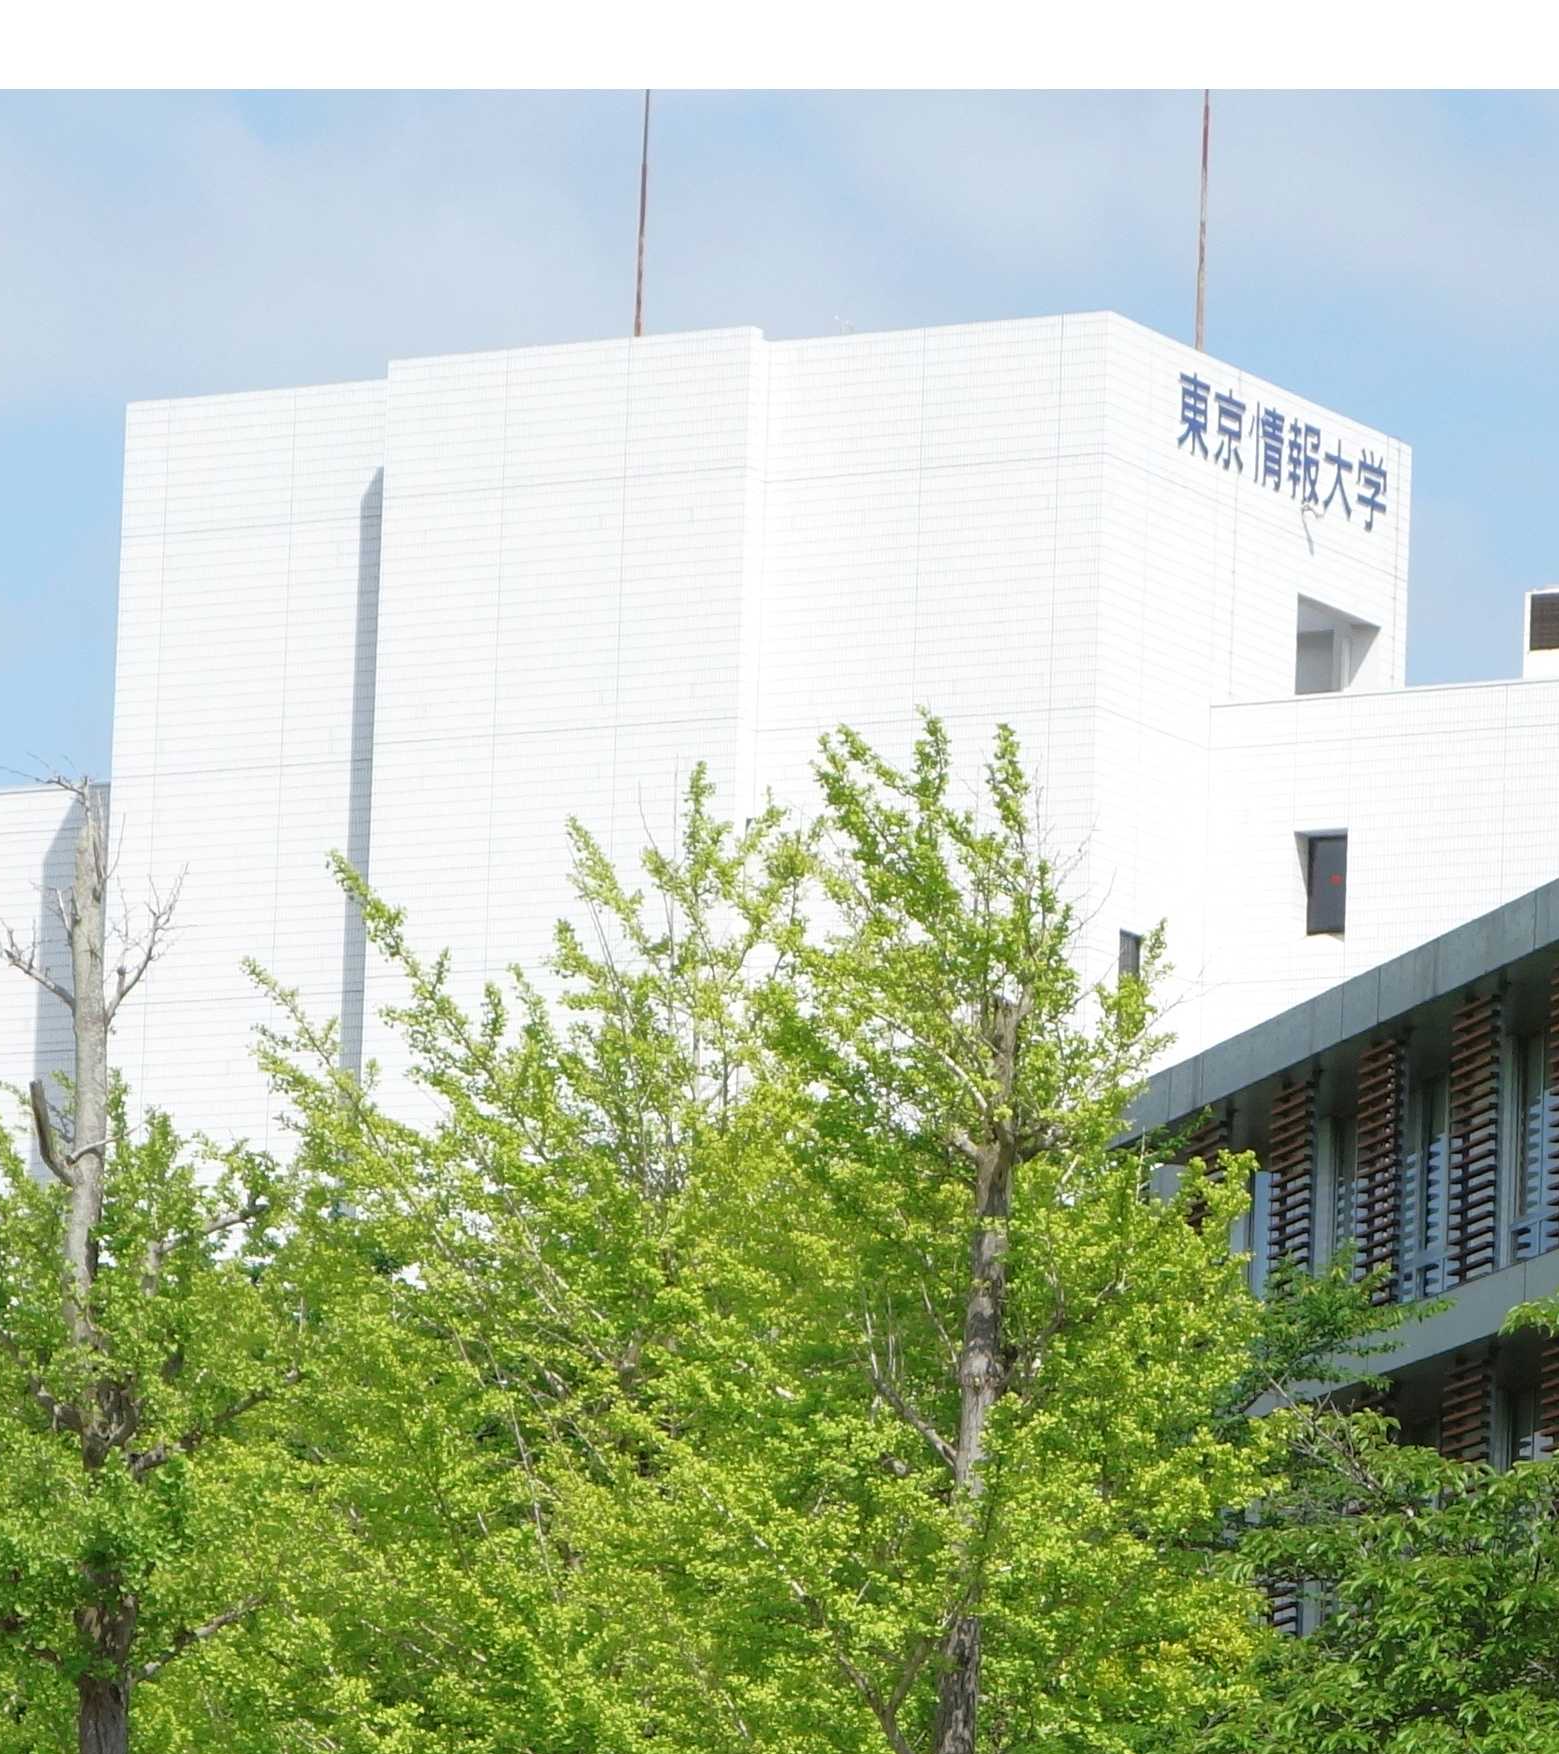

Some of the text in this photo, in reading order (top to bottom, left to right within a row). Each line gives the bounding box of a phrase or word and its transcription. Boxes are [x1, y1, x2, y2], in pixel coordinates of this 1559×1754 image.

[1177, 372, 1388, 532] 東京情報大学
